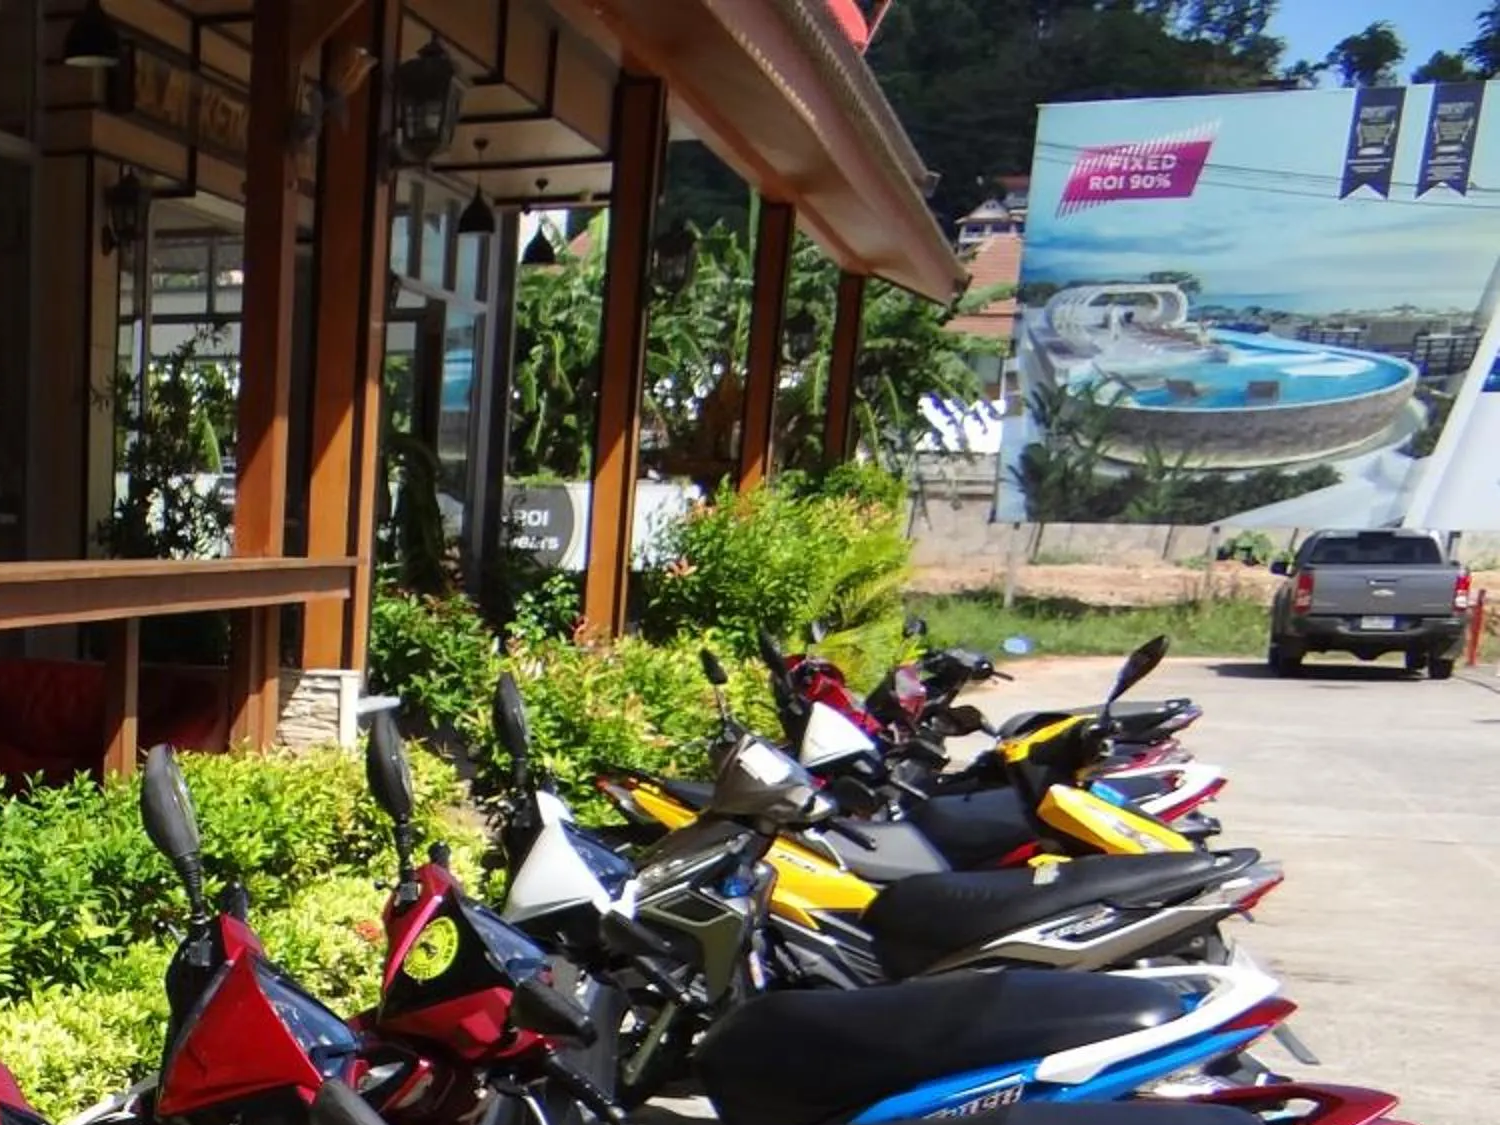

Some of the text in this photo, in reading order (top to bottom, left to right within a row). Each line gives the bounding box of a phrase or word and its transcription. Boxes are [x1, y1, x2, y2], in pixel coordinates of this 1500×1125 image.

[1108, 153, 1178, 172] FIXED
[1088, 172, 1172, 191] ROI 90%
